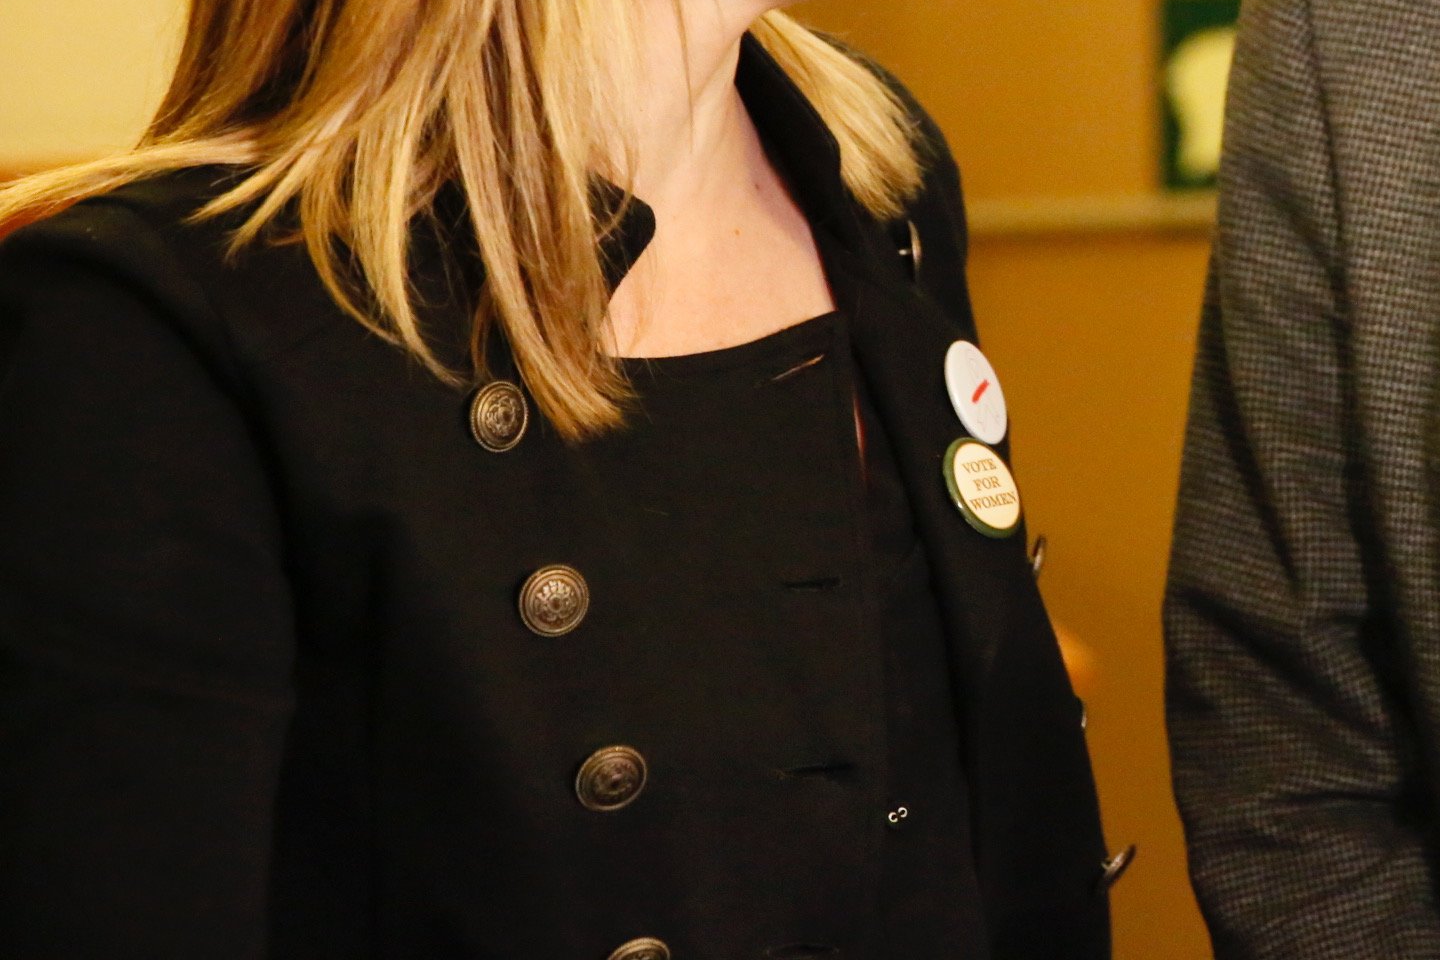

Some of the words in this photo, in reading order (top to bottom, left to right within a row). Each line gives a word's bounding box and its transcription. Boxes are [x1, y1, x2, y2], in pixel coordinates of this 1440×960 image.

[962, 458, 997, 473] VOTE
[973, 476, 1001, 491] FOR
[969, 492, 1017, 510] WOMEN
